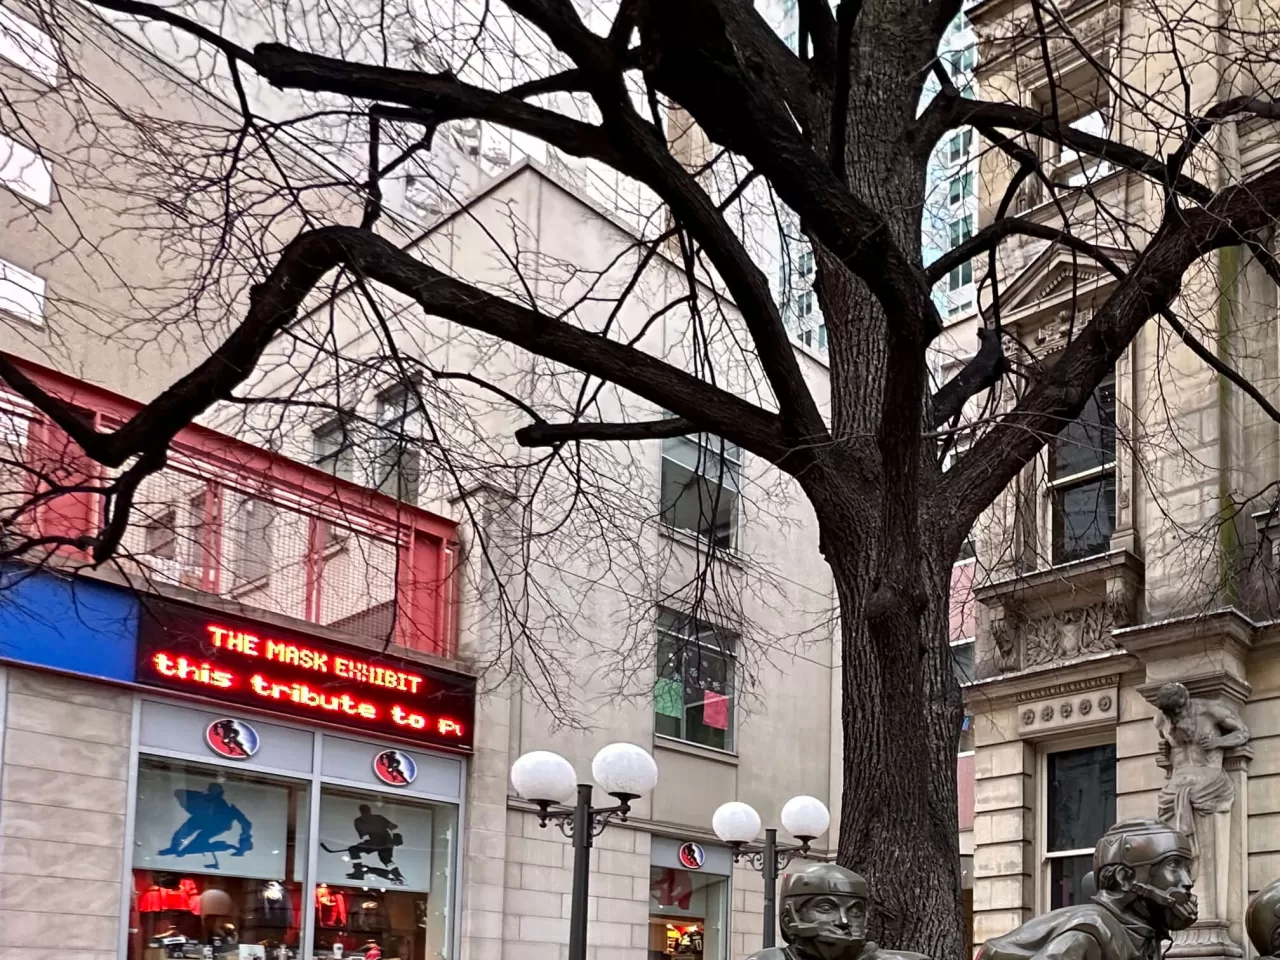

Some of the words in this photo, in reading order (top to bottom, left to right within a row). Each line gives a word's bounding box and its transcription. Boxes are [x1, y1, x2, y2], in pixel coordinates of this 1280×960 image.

[206, 625, 260, 656] THE
[265, 639, 329, 673] MASK
[152, 653, 234, 688] this
[250, 674, 377, 719] tribute
[390, 704, 426, 729] to
